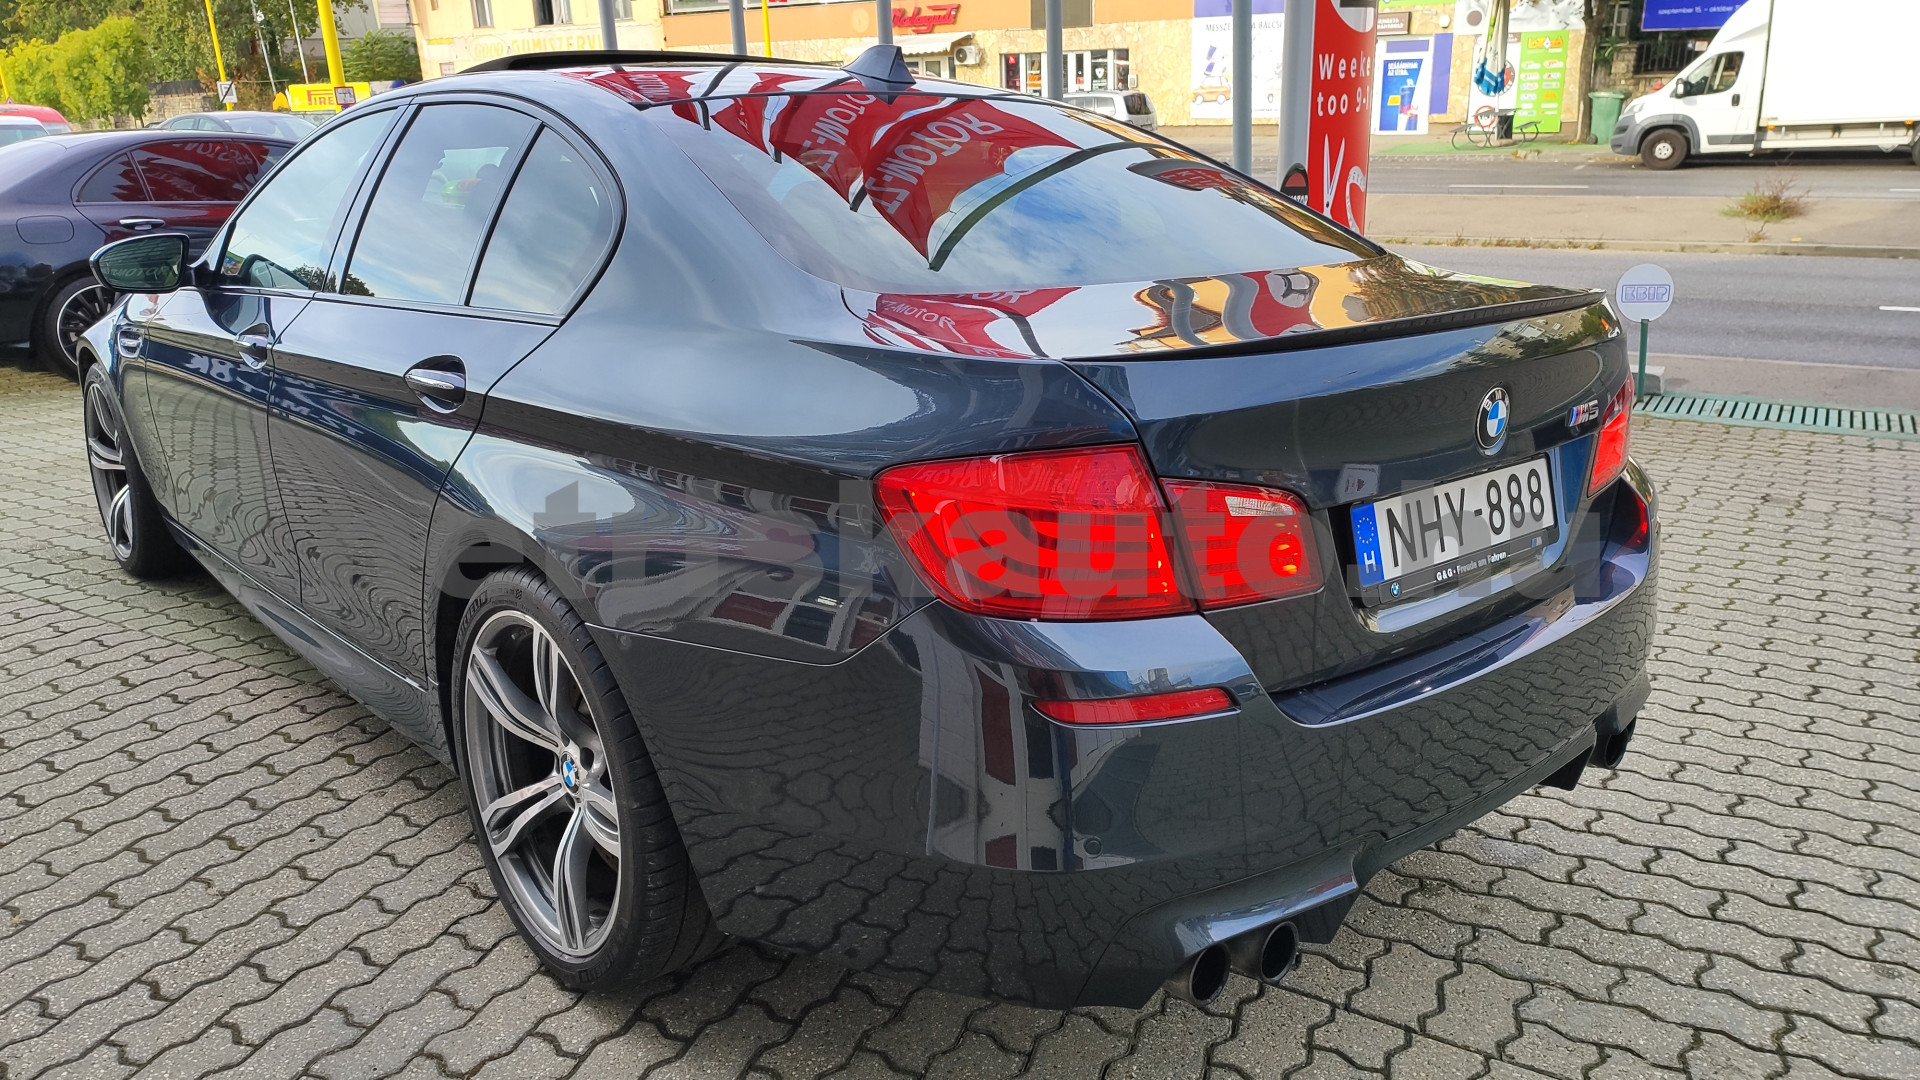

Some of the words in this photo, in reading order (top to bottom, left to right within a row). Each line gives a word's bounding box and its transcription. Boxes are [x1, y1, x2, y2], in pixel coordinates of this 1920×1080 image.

[511, 34, 603, 55] GUMISZERVI
[306, 89, 335, 106] PIRE
[1316, 91, 1349, 117] too
[1386, 467, 1545, 568] NHY-888
[1363, 550, 1377, 575] H
[1456, 560, 1478, 575] Freude
[1478, 558, 1488, 568] am
[1487, 551, 1507, 564] Fahren
